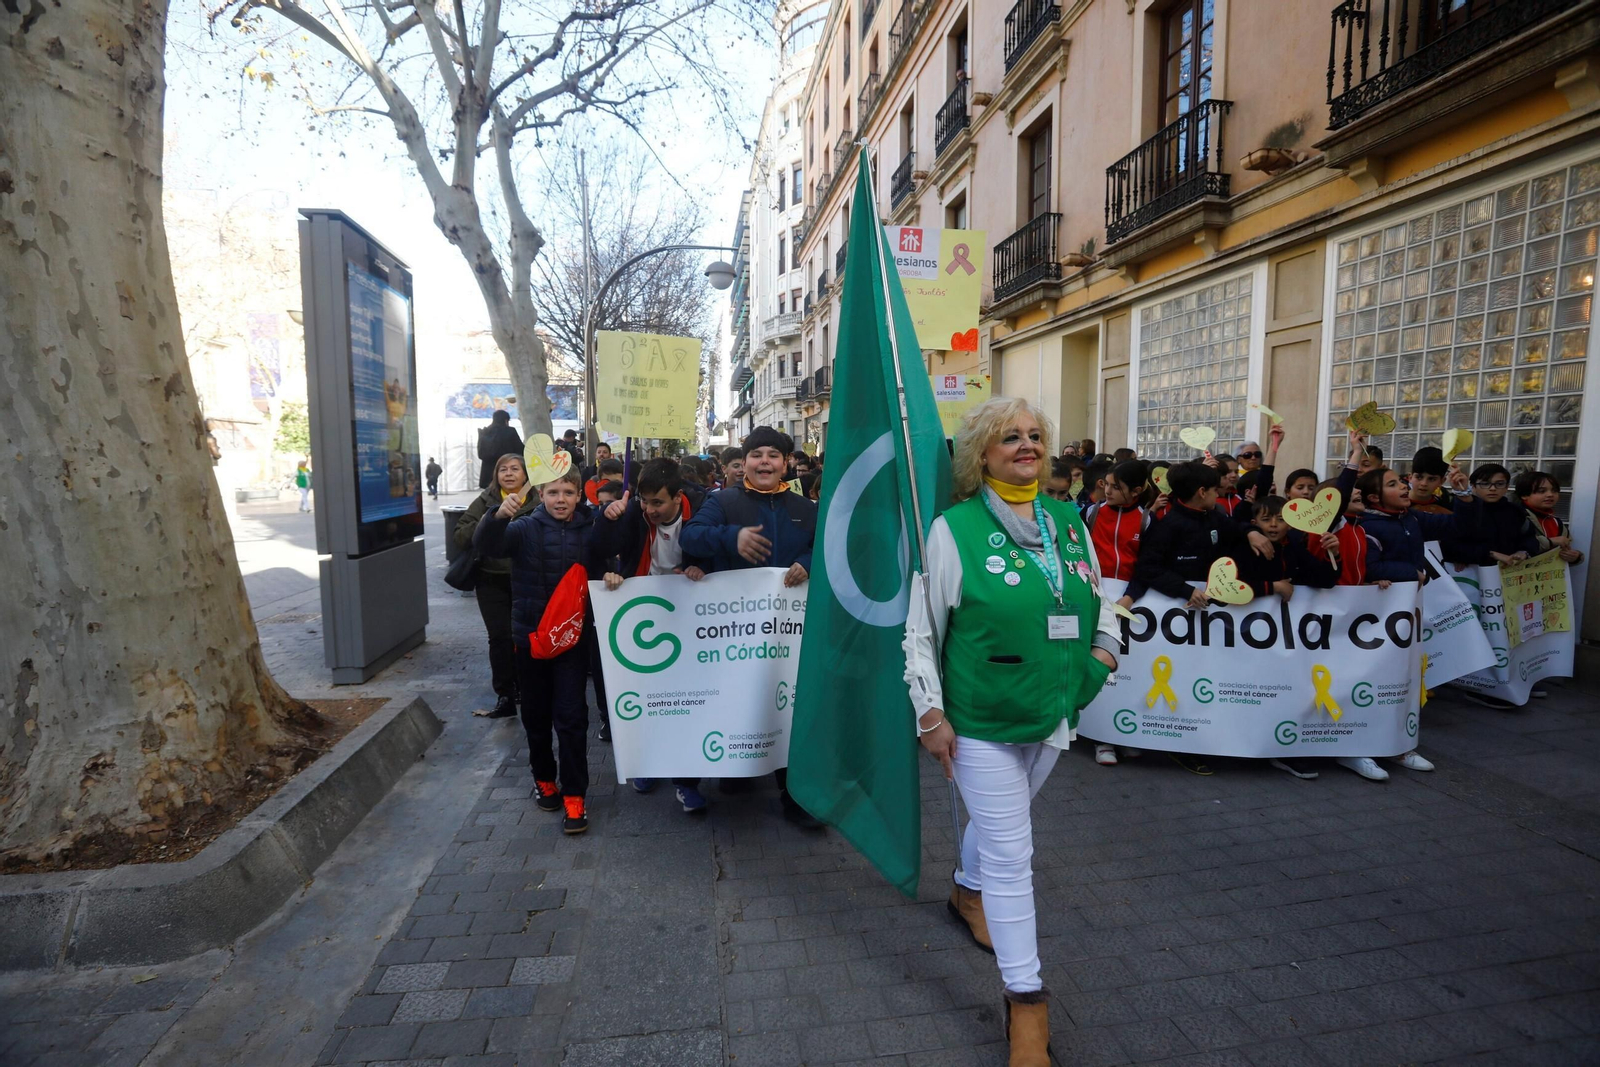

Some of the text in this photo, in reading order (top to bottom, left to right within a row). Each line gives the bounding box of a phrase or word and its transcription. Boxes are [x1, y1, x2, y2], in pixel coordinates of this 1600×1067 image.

[893, 254, 938, 269] lesianos
[694, 594, 787, 616] asociación
[1481, 603, 1505, 615] con
[696, 617, 803, 640] contra el cán
[1119, 598, 1332, 655] pañola
[697, 641, 790, 664] en Córdoba
[1259, 683, 1293, 691] española
[647, 689, 720, 699] asociación española
[647, 700, 672, 708] contra
[1229, 697, 1261, 705] Córdoba
[658, 708, 690, 716] Córdoba
[1142, 714, 1212, 725] asociación española
[1142, 721, 1165, 729] contra
[1174, 723, 1198, 731] cáncer
[1302, 721, 1368, 729] asociación española
[728, 731, 767, 740] asociación
[1152, 729, 1182, 738] Córdoba
[728, 741, 753, 750] contra
[754, 741, 761, 749] el
[738, 750, 768, 759] Córdoba
